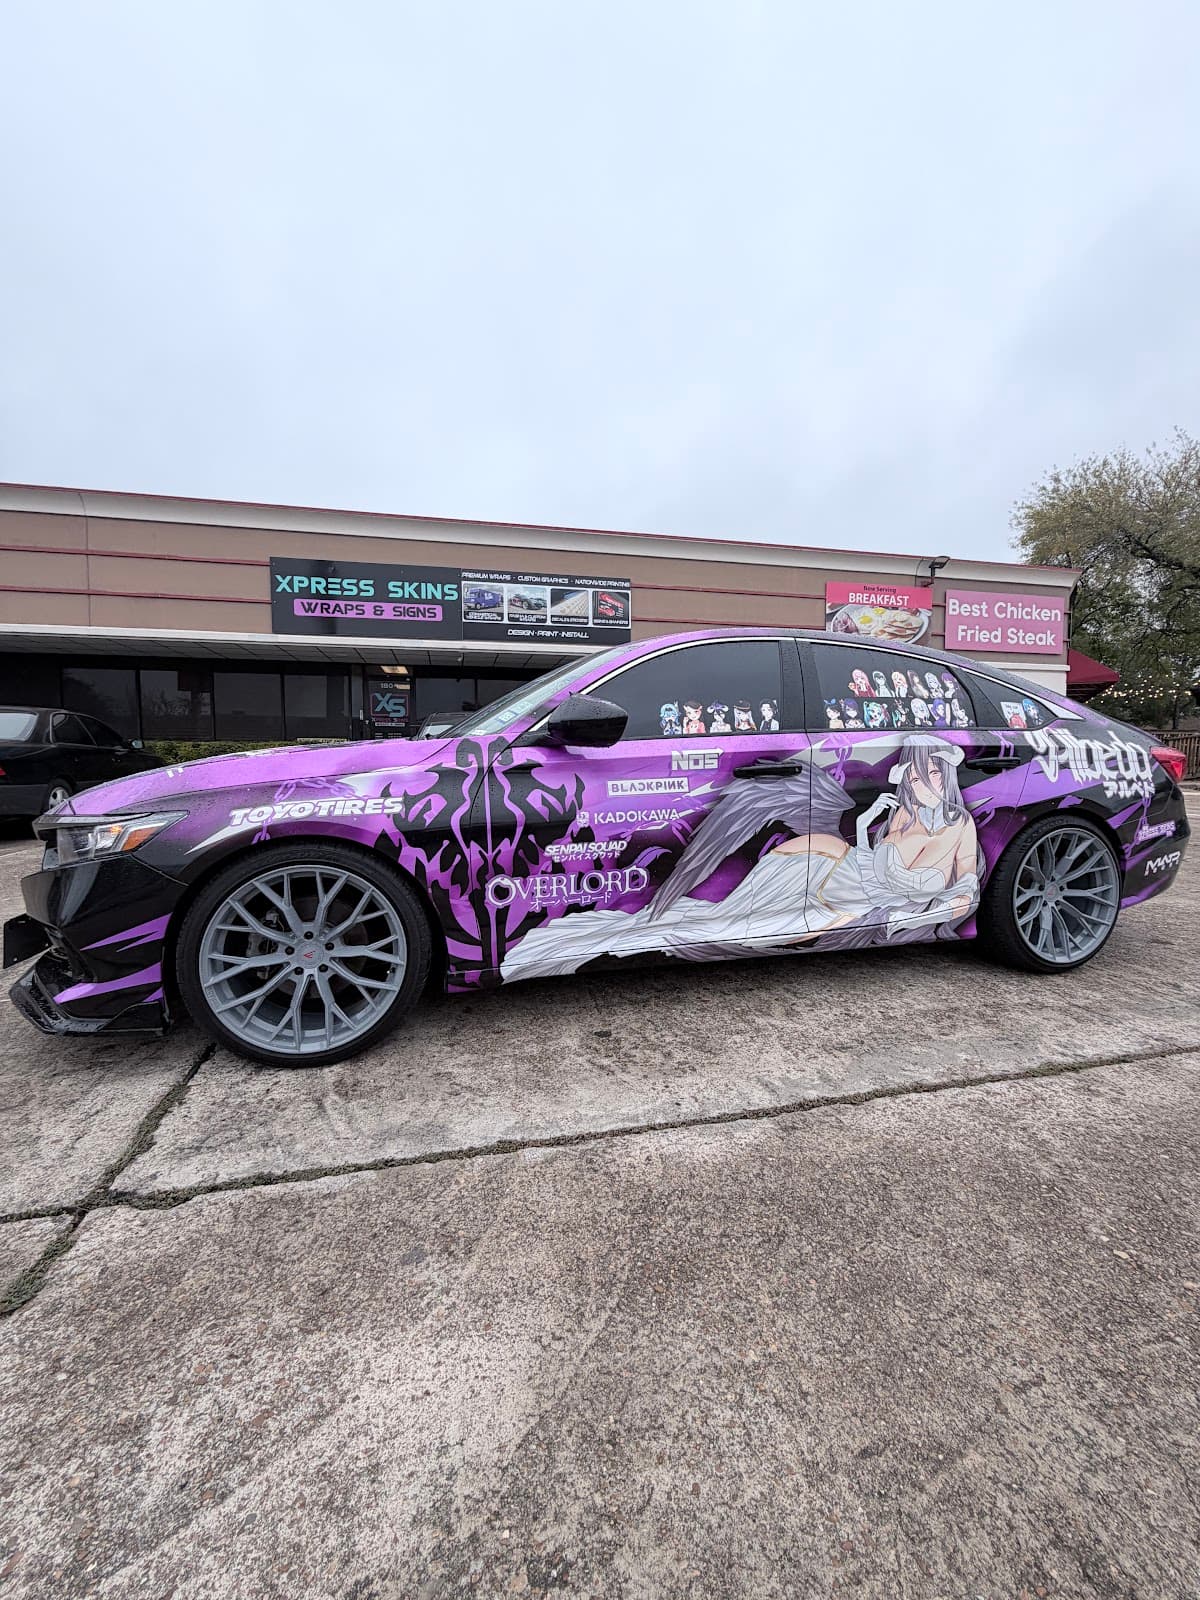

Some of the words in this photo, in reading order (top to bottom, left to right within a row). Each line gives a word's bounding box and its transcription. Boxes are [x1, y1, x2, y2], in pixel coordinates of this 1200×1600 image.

[462, 571, 489, 579] PREMIUM
[488, 573, 511, 581] WRAPS
[541, 576, 569, 584] GRAPHICS
[274, 574, 375, 597] XPRESS
[387, 581, 459, 601] SKINS
[876, 586, 897, 594] Serving
[848, 592, 910, 606] BREAKFAST
[300, 601, 365, 615] WRAPS
[373, 605, 385, 616] &
[392, 606, 437, 618] SIGNS
[948, 598, 989, 618] Best
[994, 601, 1061, 622] Chicken
[957, 625, 1002, 643] Fried
[1007, 627, 1056, 646] Steak
[374, 692, 406, 718] XS
[671, 748, 723, 771] NOS
[611, 780, 685, 793] BLACKPINK
[229, 801, 315, 826] TOYO
[316, 797, 403, 817] TIRES
[594, 808, 680, 825] KADOKAWA
[543, 842, 588, 857] SENPAI
[587, 840, 628, 853] SQUAD
[487, 865, 649, 906] OVERLORD
